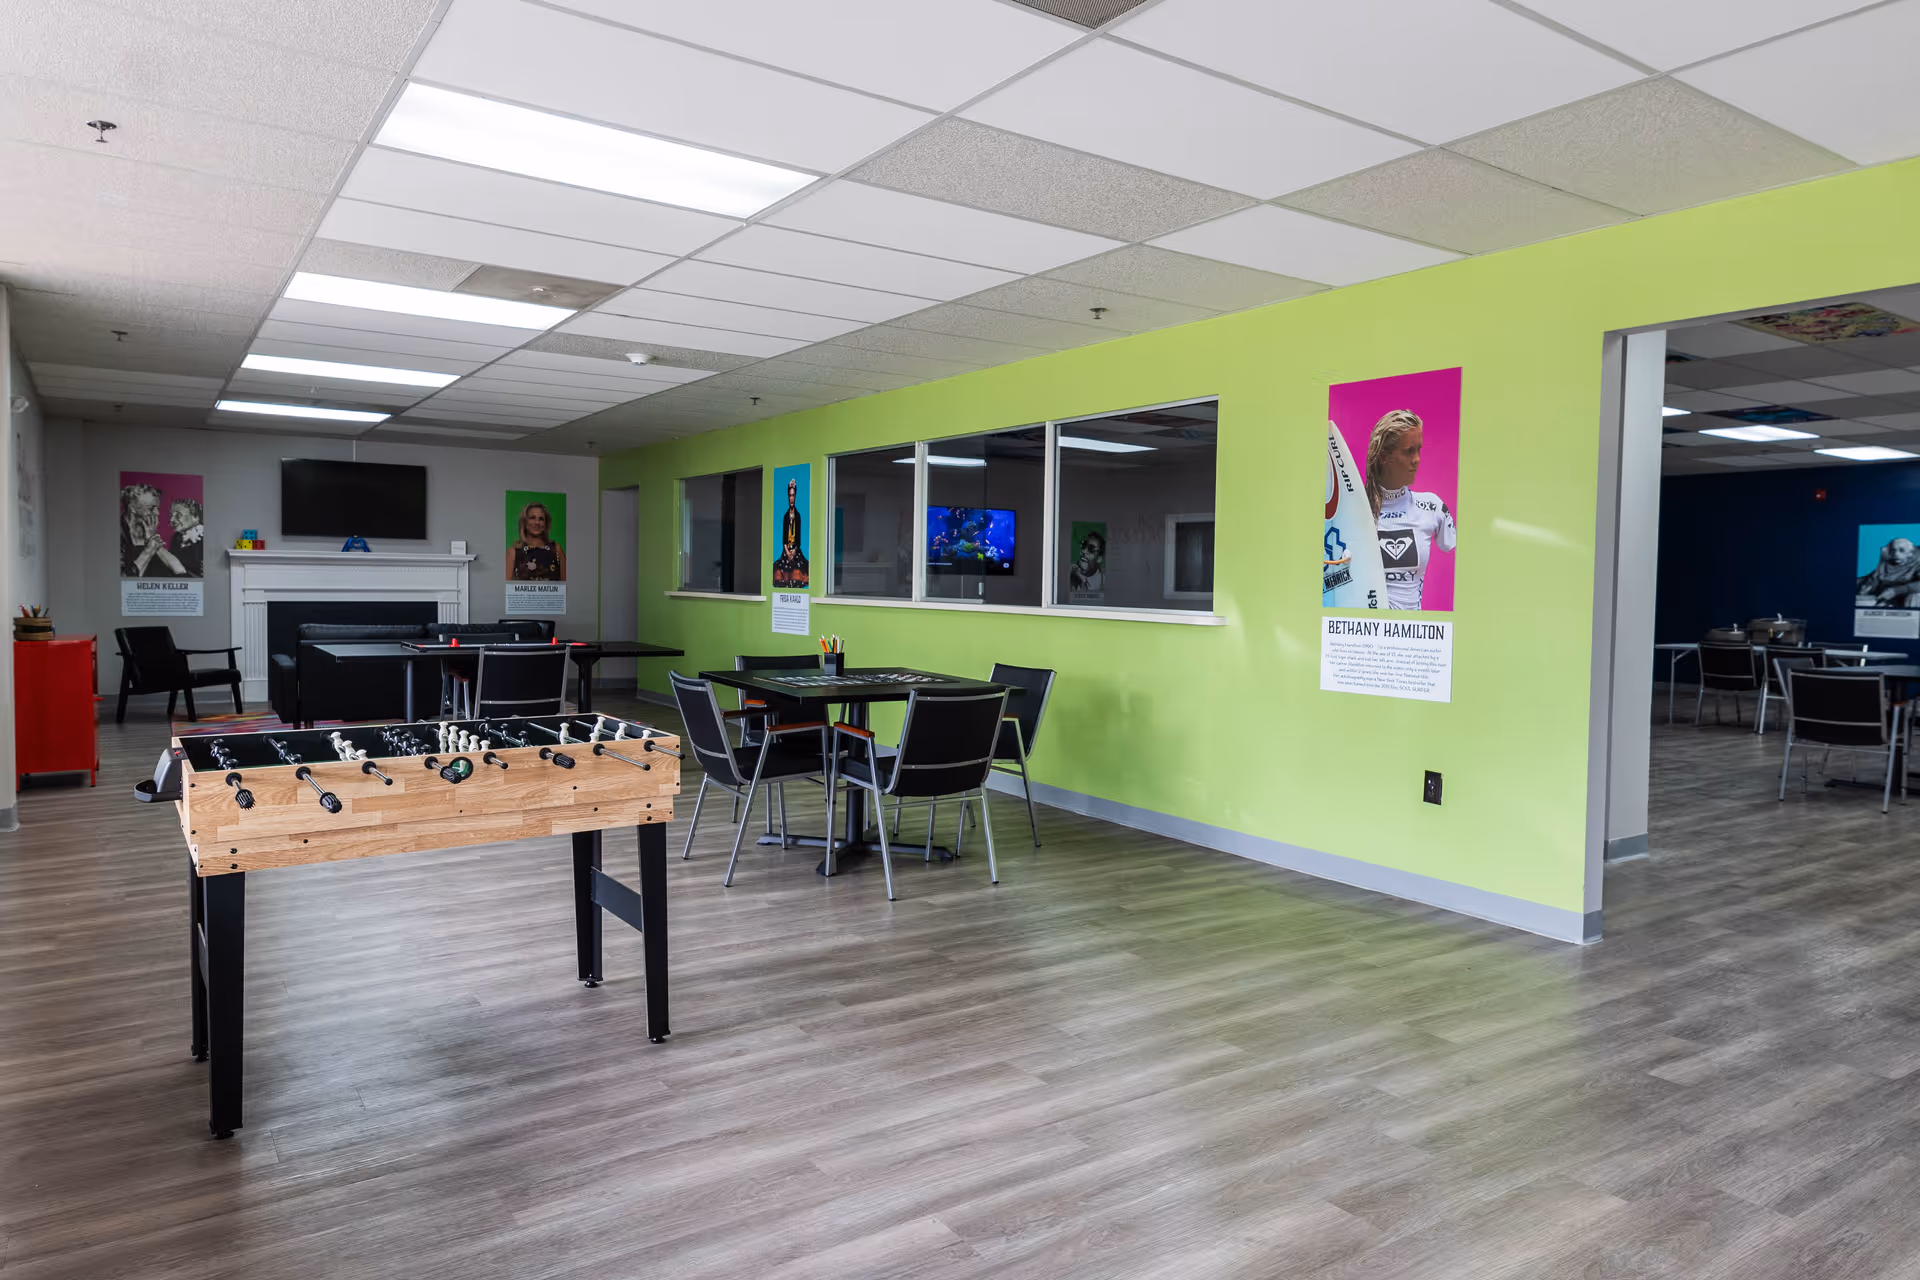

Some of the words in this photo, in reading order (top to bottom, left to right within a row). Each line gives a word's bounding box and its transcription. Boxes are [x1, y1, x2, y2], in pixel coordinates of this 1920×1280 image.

[1324, 568, 1352, 590] MERRICK
[1385, 571, 1417, 581] OXY
[1328, 620, 1380, 636] BETHANY
[1384, 623, 1444, 640] HAMILTON
